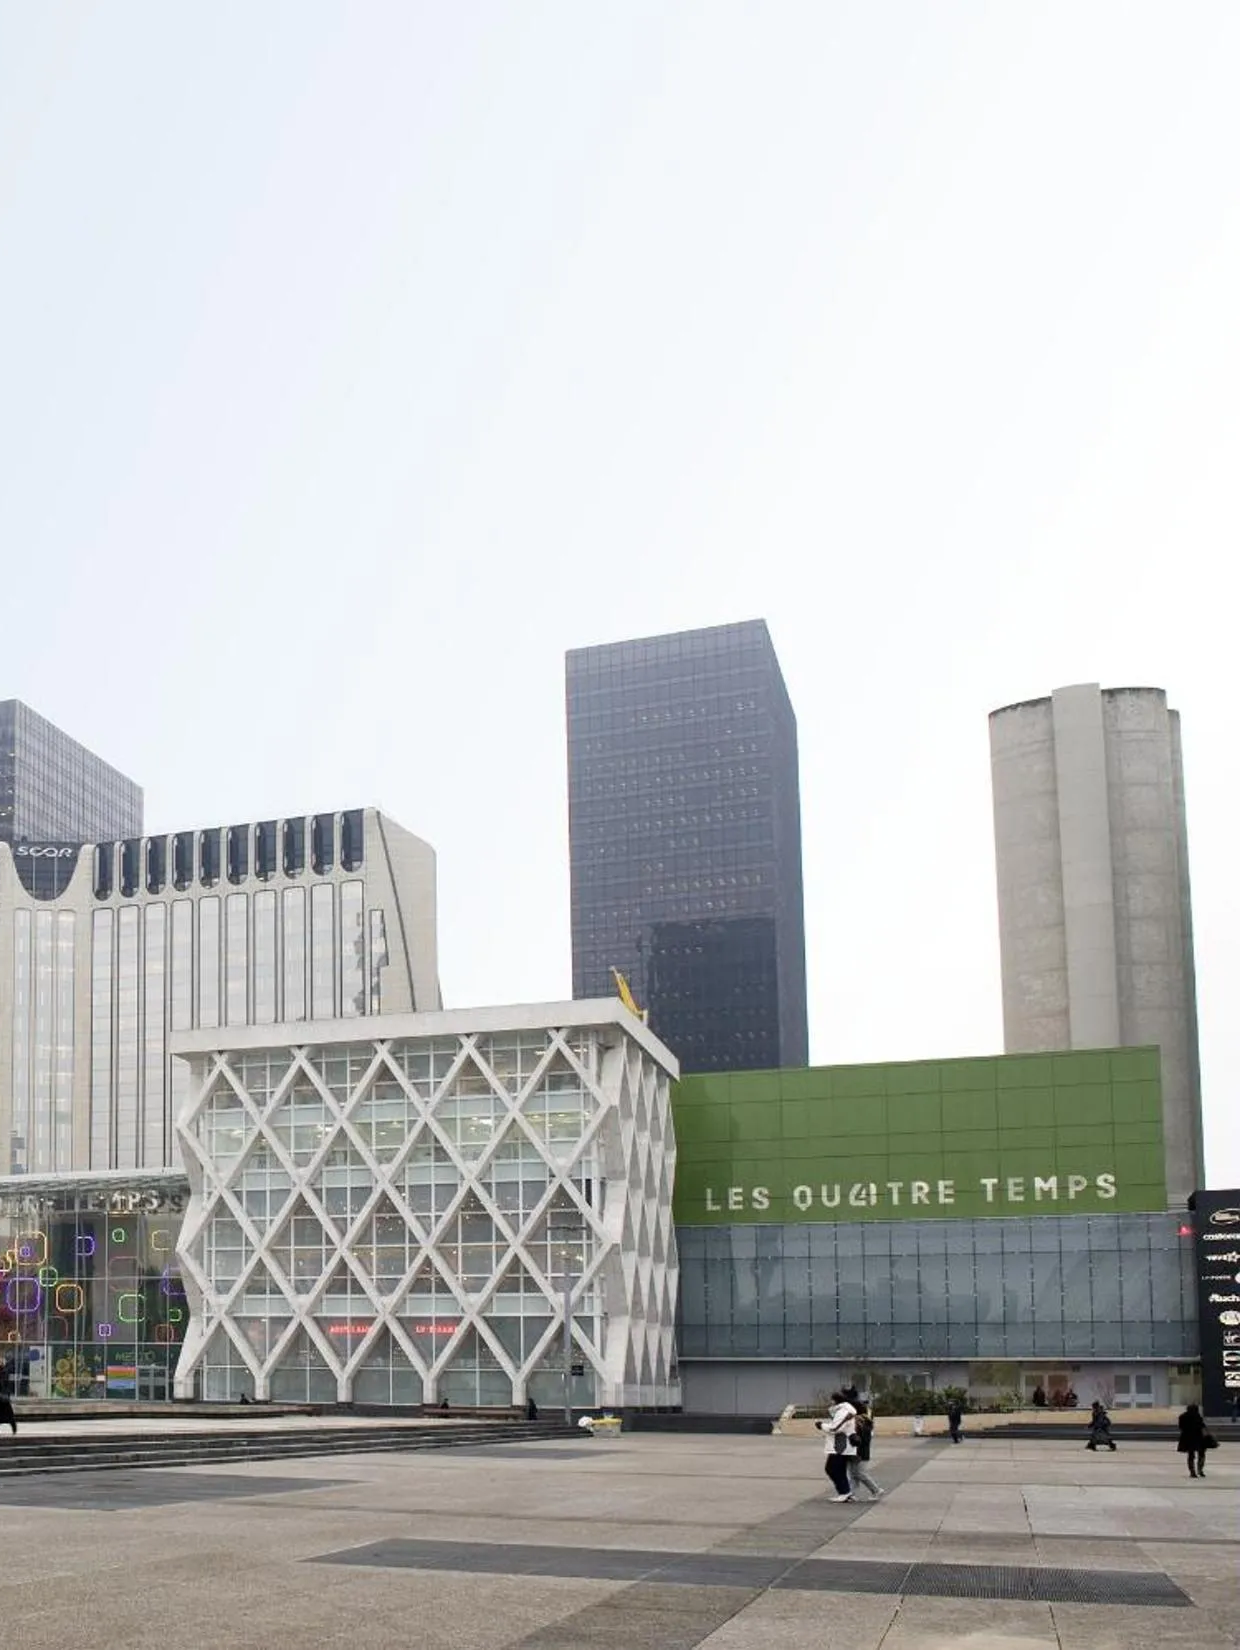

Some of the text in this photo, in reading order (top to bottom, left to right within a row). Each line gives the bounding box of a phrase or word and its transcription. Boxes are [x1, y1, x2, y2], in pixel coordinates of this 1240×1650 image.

[15, 845, 73, 858] SCOR
[705, 1186, 770, 1212] LES
[979, 1172, 1118, 1203] TEMPS
